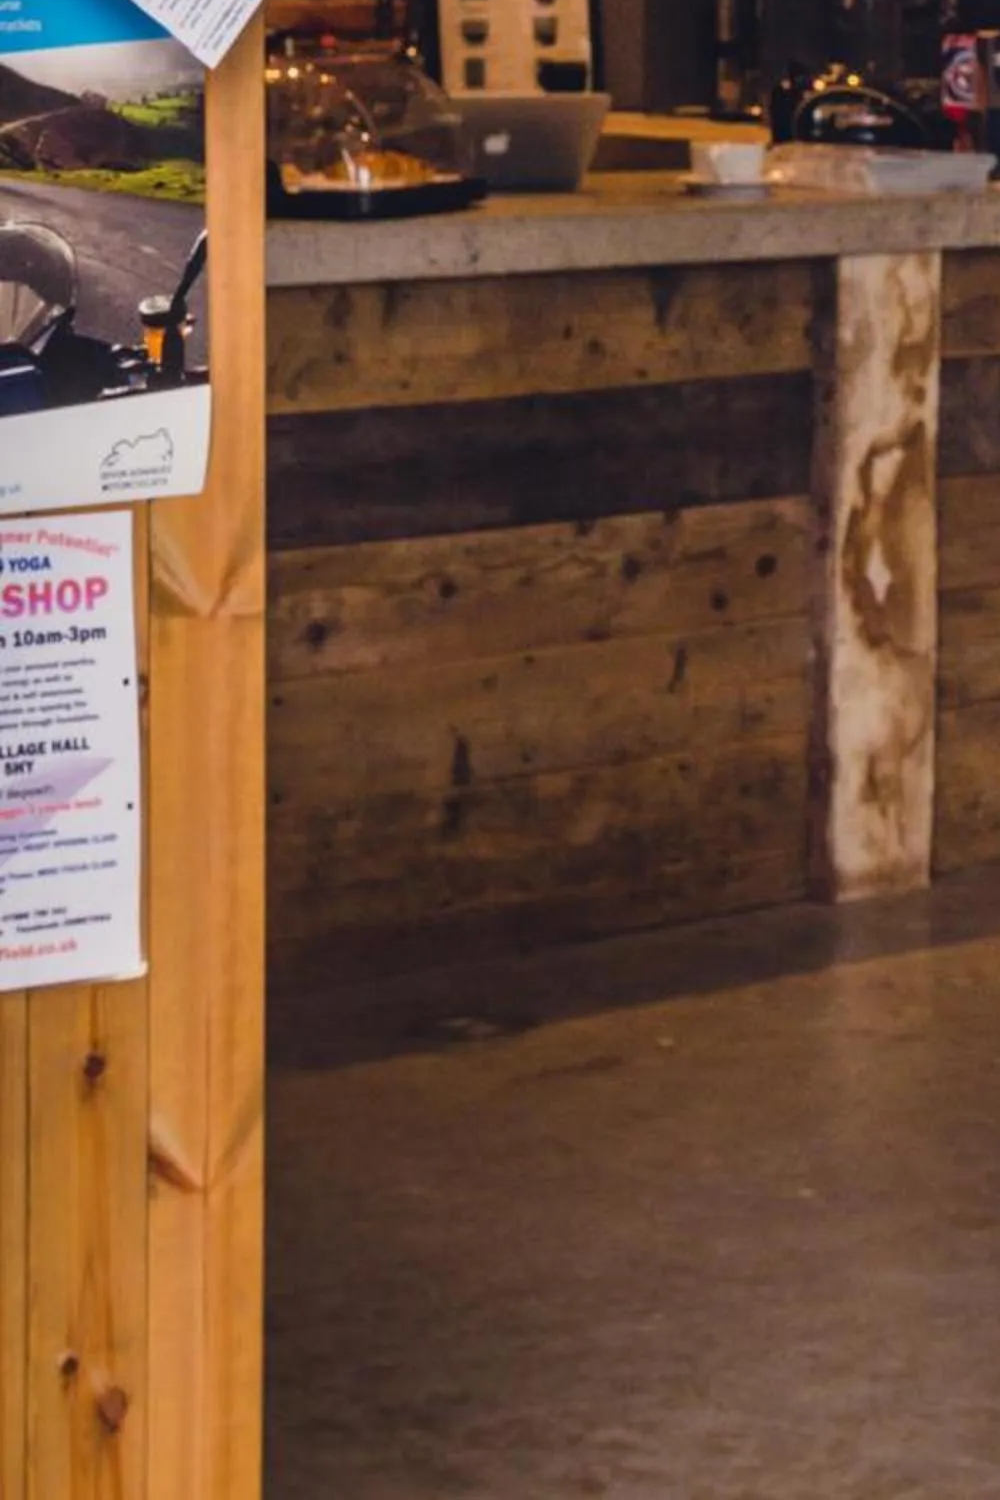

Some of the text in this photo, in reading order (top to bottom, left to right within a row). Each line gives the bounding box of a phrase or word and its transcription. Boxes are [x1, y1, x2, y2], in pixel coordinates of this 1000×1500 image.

[9, 556, 52, 572] YOGA
[1, 576, 109, 618] SHOP
[13, 624, 107, 648] 10am-3pm
[51, 736, 91, 753] HALL
